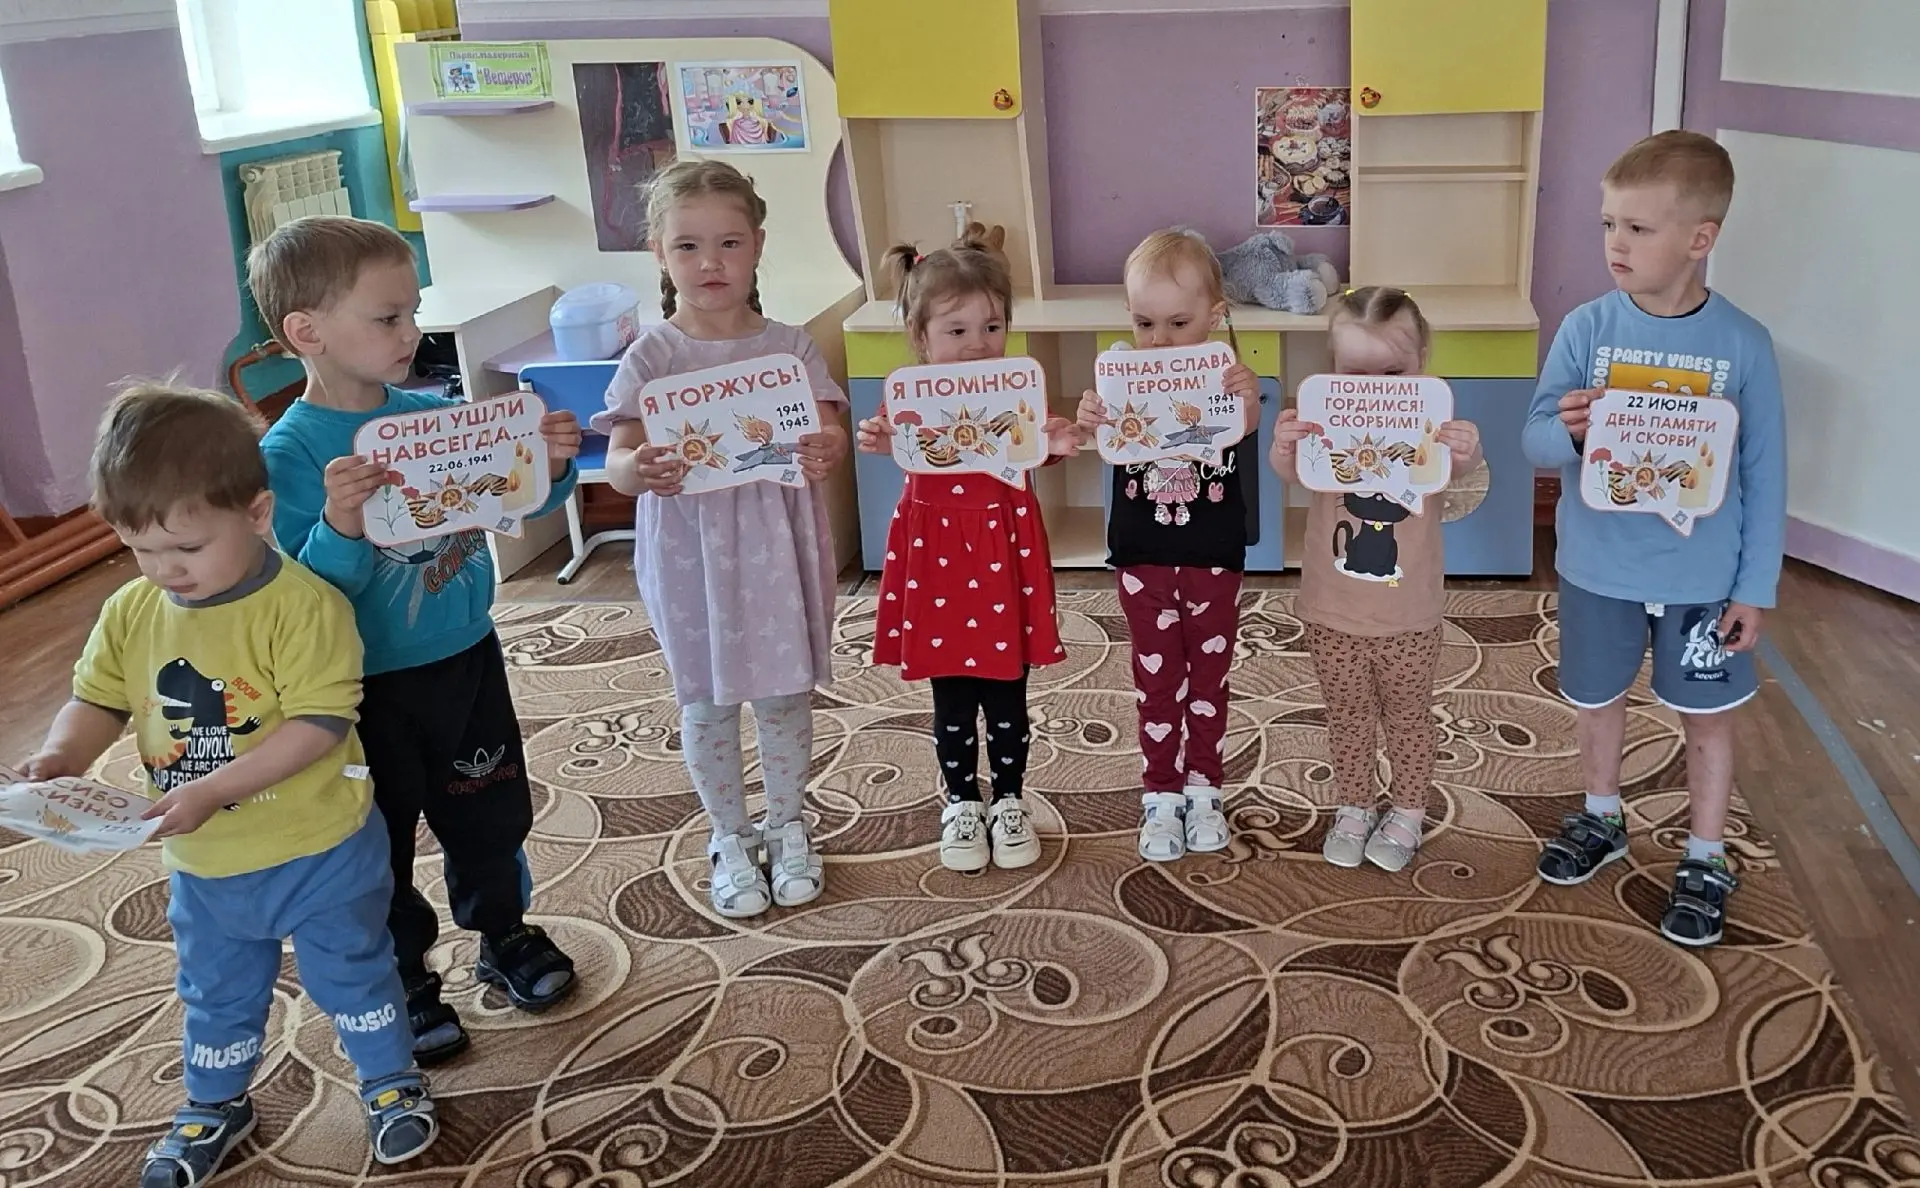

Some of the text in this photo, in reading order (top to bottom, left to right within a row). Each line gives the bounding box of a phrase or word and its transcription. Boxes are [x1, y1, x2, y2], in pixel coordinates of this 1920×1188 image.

[1099, 352, 1232, 377] ВЕЧНАЯ СЛАВА
[1611, 348, 1713, 373] PARTY VIBES
[643, 364, 801, 416] Я ГОРЖУСЬ!
[892, 370, 1037, 400] Я ПОМНЮ!
[1127, 374, 1207, 395] ГЕРОЯМ!
[1330, 381, 1419, 396] ПОМНИМ!
[1208, 392, 1235, 405] 1941
[1325, 397, 1424, 413] ГОРДИМСЯ!
[1627, 396, 1698, 413] 22 ИЮНЯ
[776, 401, 806, 418] 1941
[1208, 404, 1235, 417] 1945
[378, 398, 524, 440] ОНИ УШЛИ
[779, 415, 810, 432] 1945
[1329, 414, 1419, 429] СКОРБИМ!
[1605, 412, 1718, 433] ДЕНЬ ПАМЯТИ
[372, 426, 534, 465] НАВСЕГДА...
[1620, 431, 1697, 447] И СКОРБИ
[428, 453, 494, 474] 22.06.1941
[191, 726, 228, 736] WE LOVE
[180, 760, 193, 771] WE
